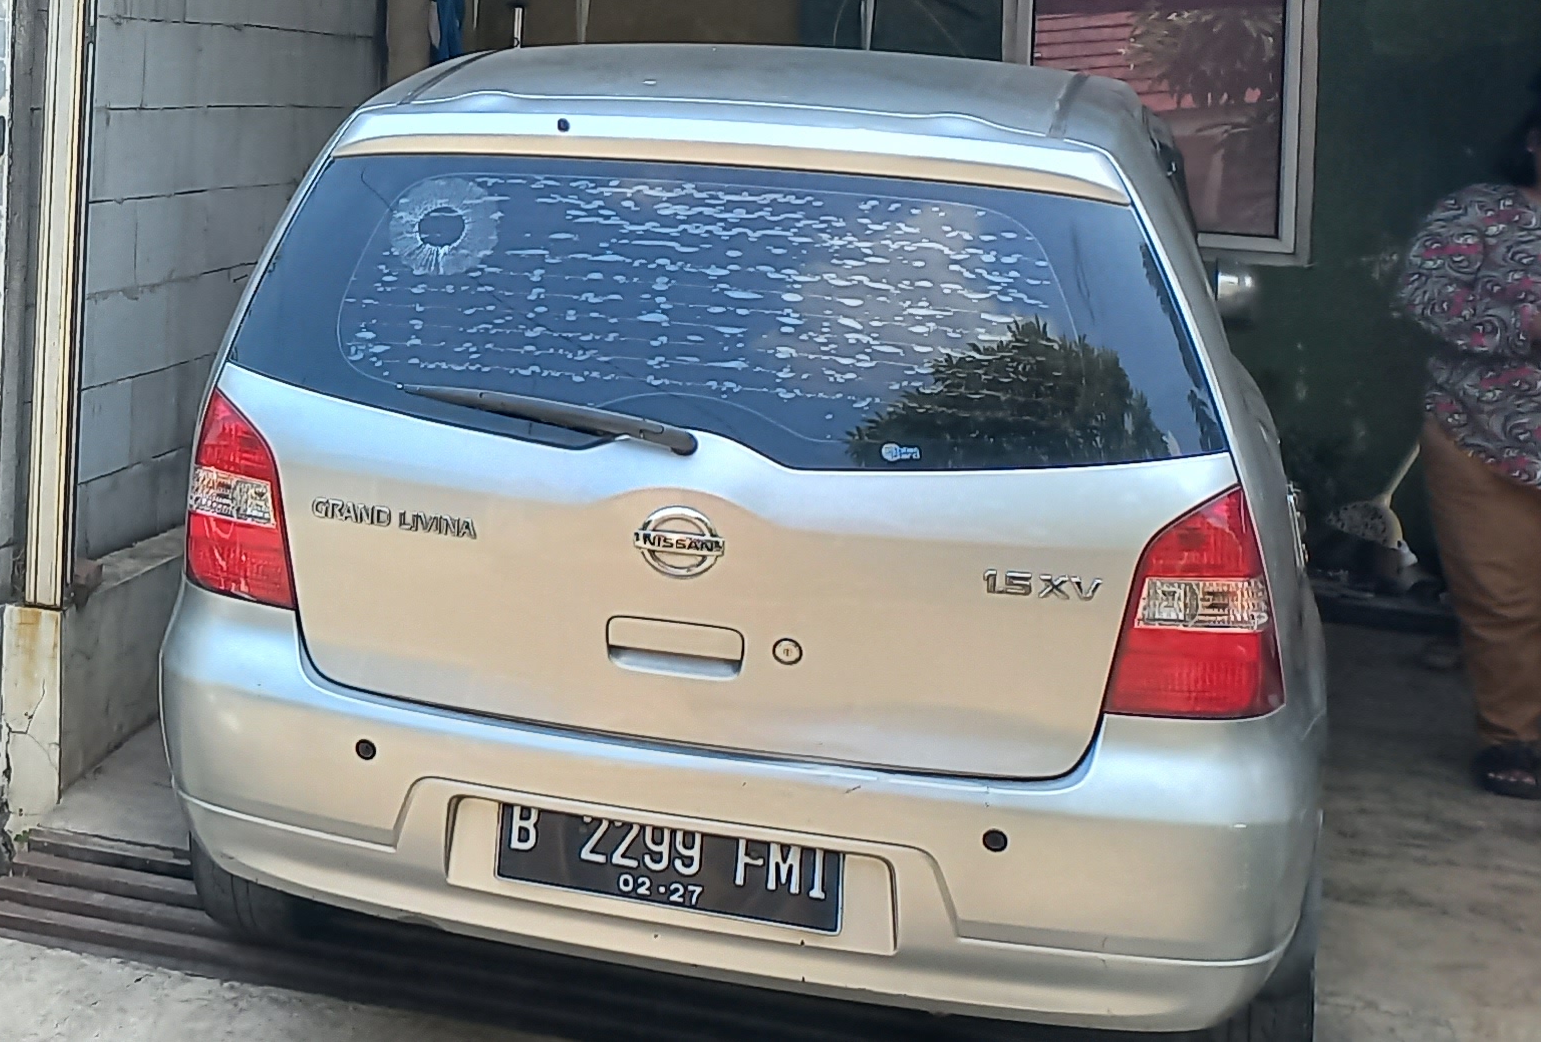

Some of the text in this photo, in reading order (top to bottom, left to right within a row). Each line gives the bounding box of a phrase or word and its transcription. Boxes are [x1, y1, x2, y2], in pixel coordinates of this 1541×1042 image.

[311, 495, 478, 540] GRAND LIVINA
[641, 531, 716, 553] NISSAN
[1037, 574, 1104, 601] XV
[509, 805, 539, 852] B
[578, 815, 703, 876] 2299
